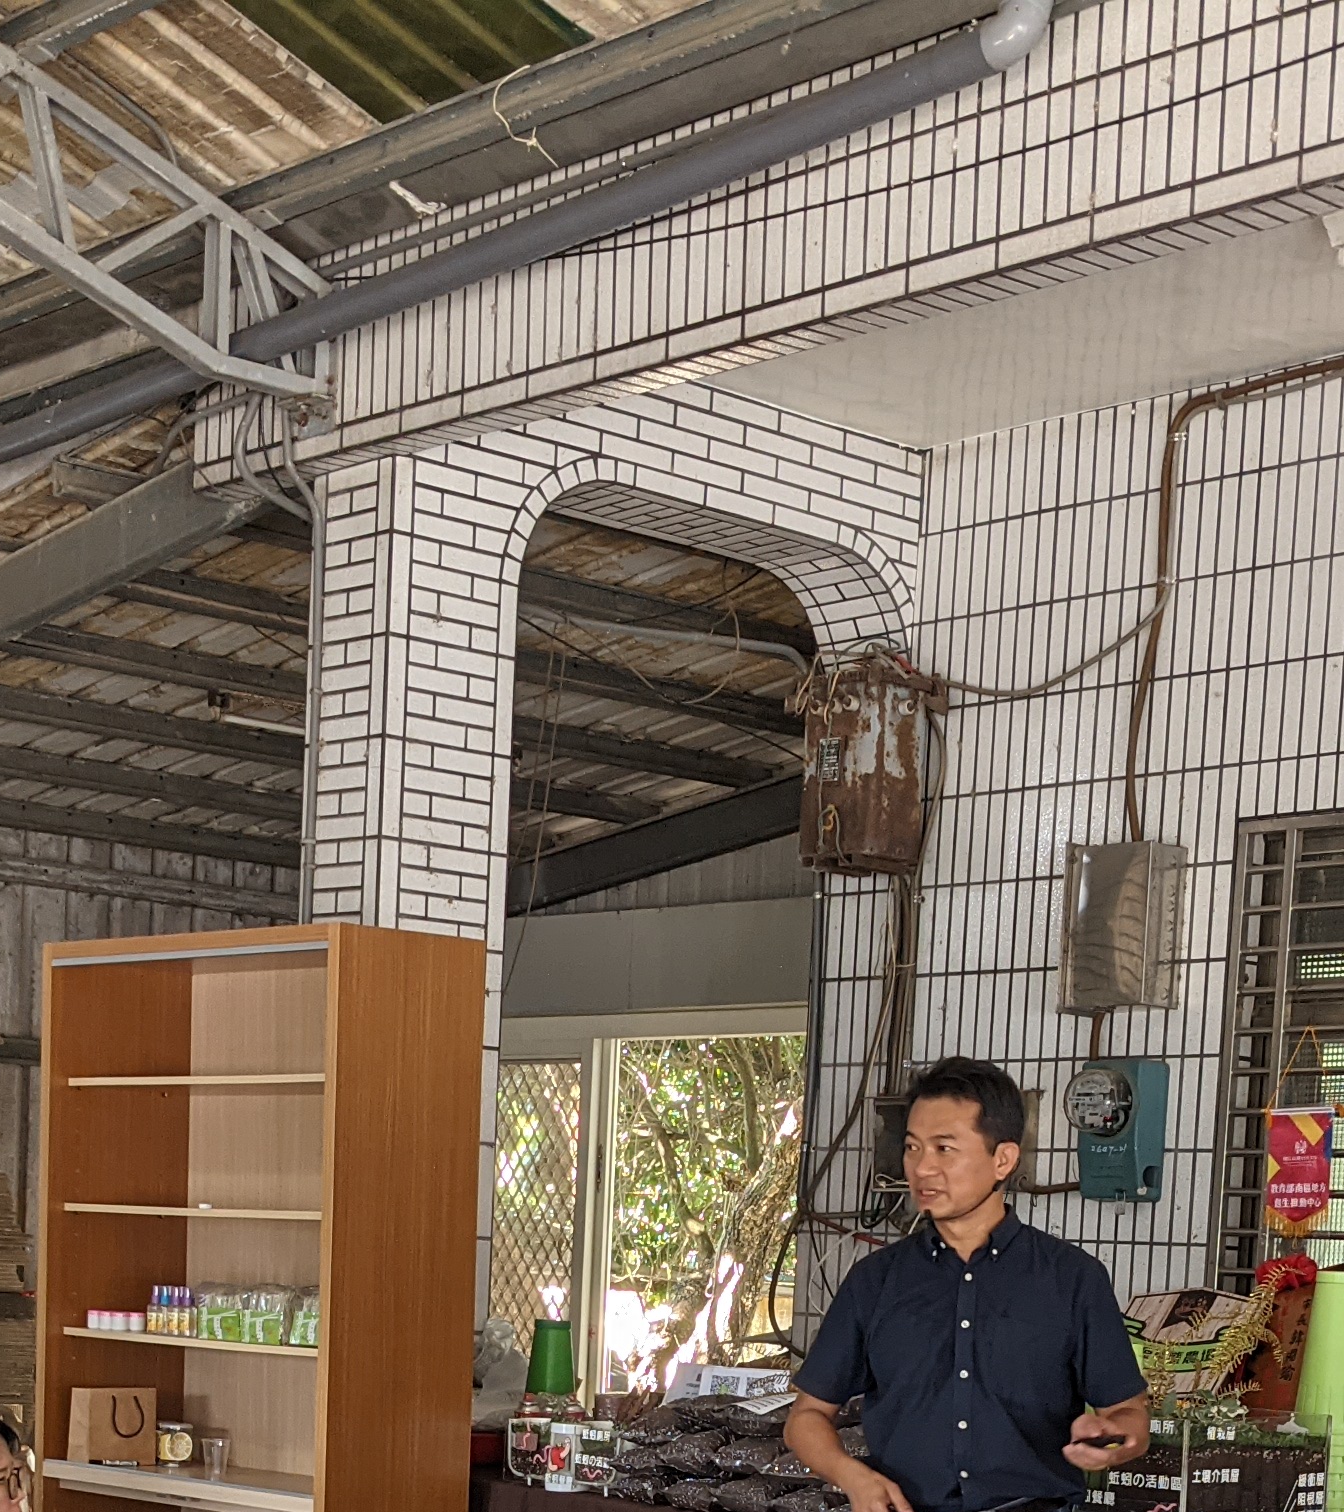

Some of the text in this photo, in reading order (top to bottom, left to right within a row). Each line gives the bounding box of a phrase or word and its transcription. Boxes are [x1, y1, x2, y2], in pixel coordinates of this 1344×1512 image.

[1191, 1467, 1240, 1484] 土壤介質層
